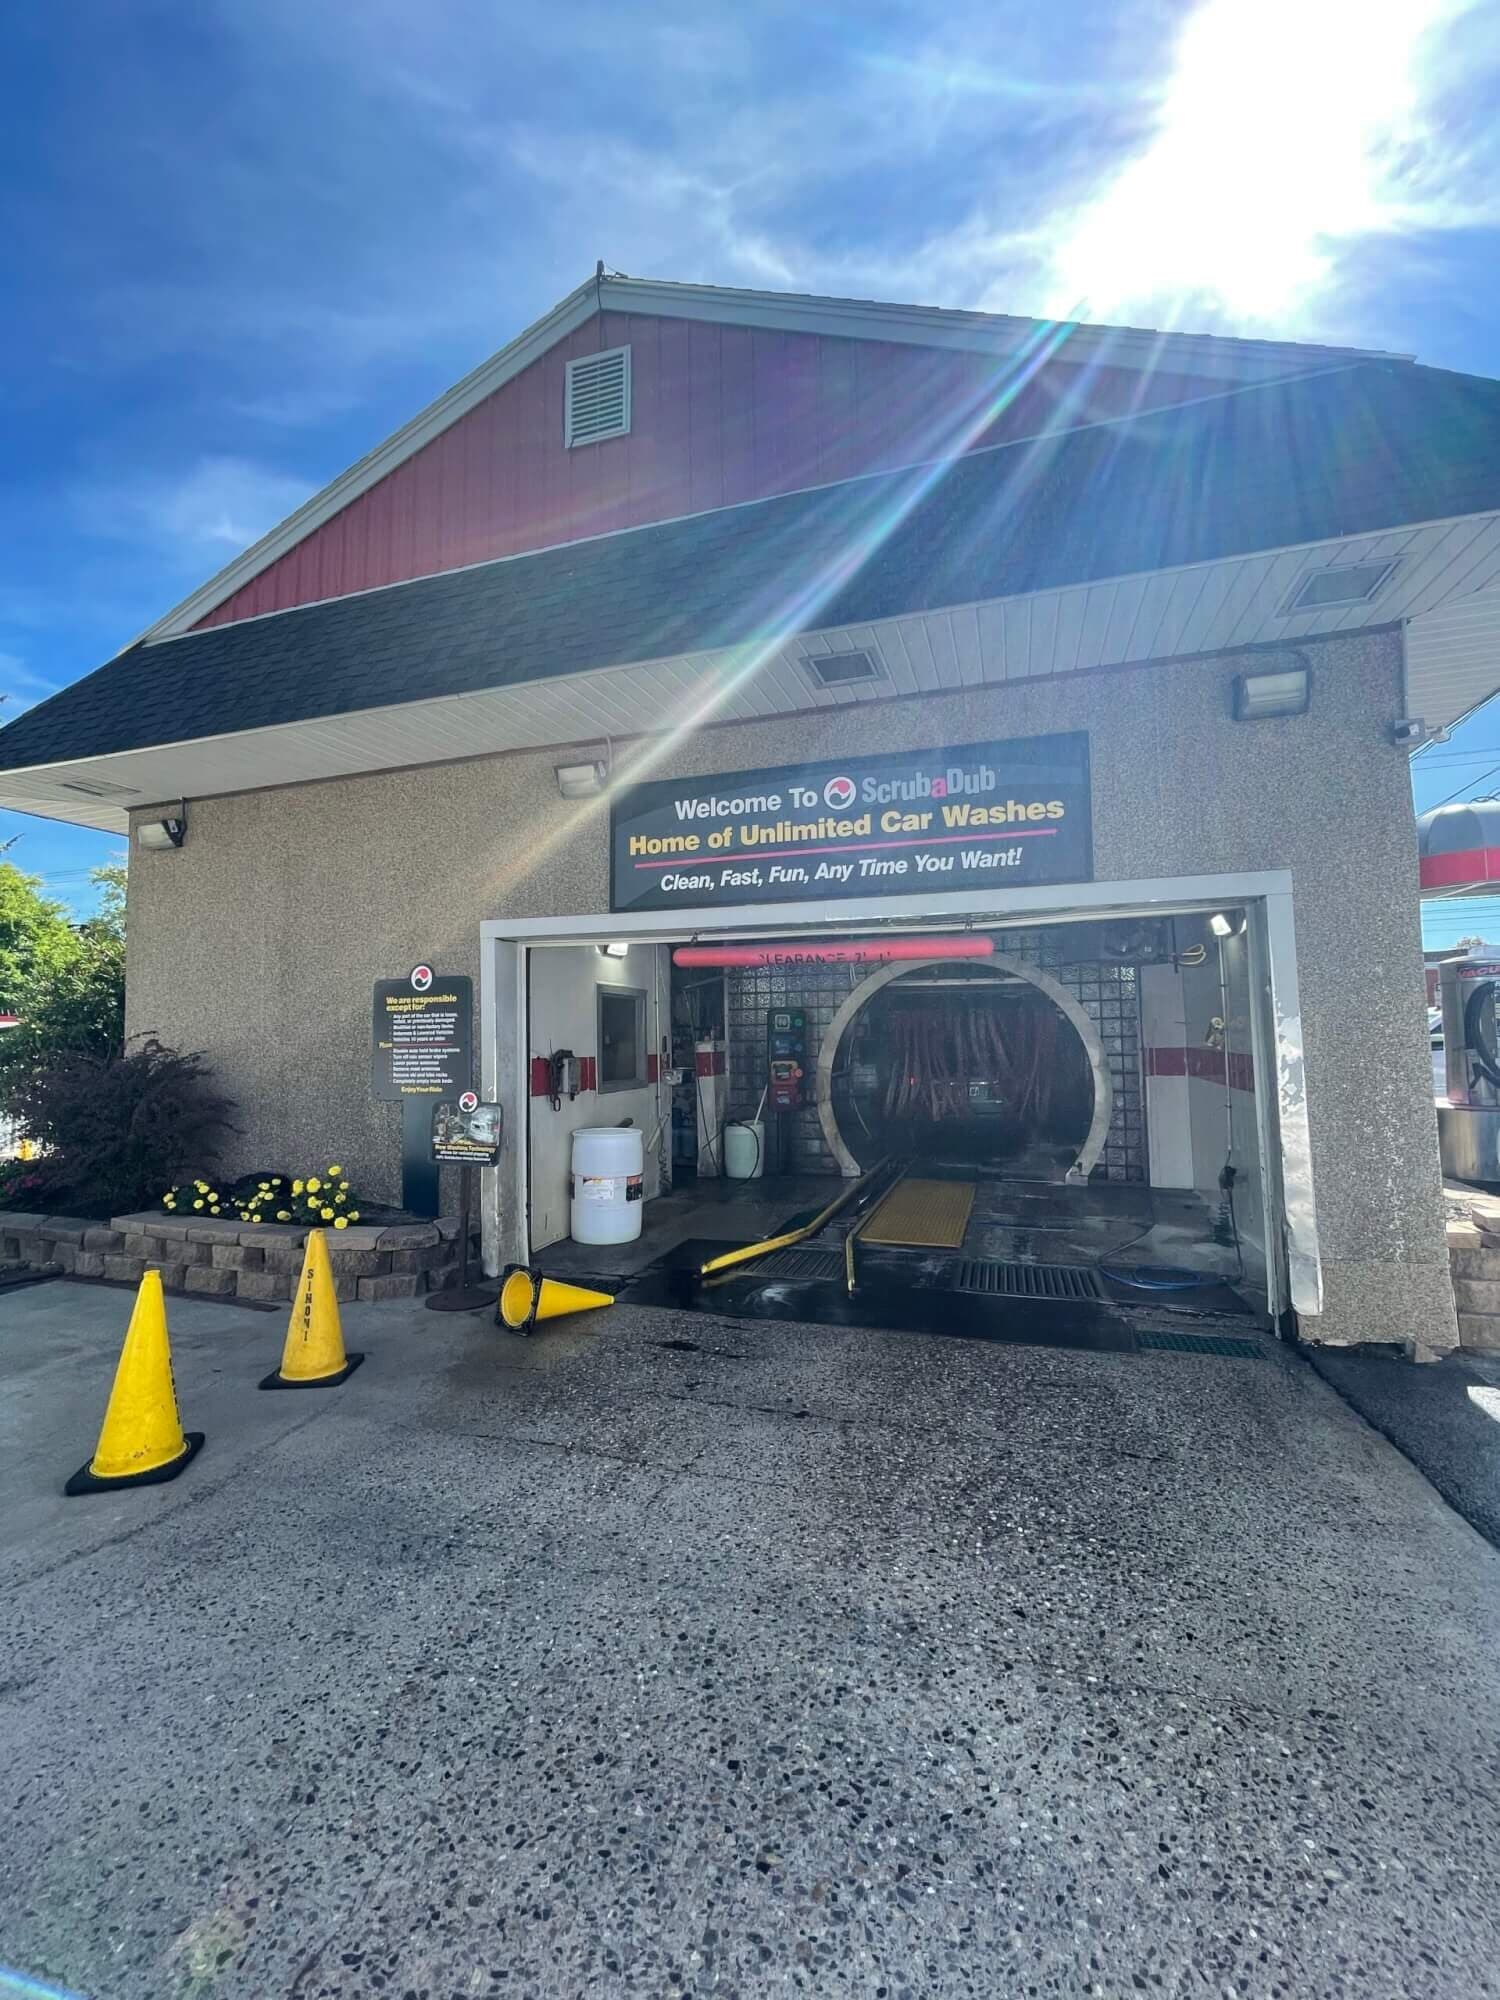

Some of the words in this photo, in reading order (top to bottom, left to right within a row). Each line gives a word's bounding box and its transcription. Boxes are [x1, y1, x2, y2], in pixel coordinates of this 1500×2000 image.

[674, 794, 782, 820] Welcome
[788, 787, 818, 808] To
[862, 765, 996, 804] ScrubaDub
[629, 834, 700, 856] Home
[707, 826, 733, 849] of
[740, 813, 872, 845] Unlimited
[880, 810, 933, 833] Car
[941, 799, 1065, 828] Washes
[661, 873, 715, 891] Clean,
[720, 869, 763, 887] Fast,
[768, 866, 809, 884] Fun,
[814, 862, 854, 882] Any
[858, 858, 908, 877] Time
[914, 854, 954, 873] You
[960, 847, 1023, 870] Want!
[386, 1004, 412, 1013] except
[411, 994, 457, 1005] responsible
